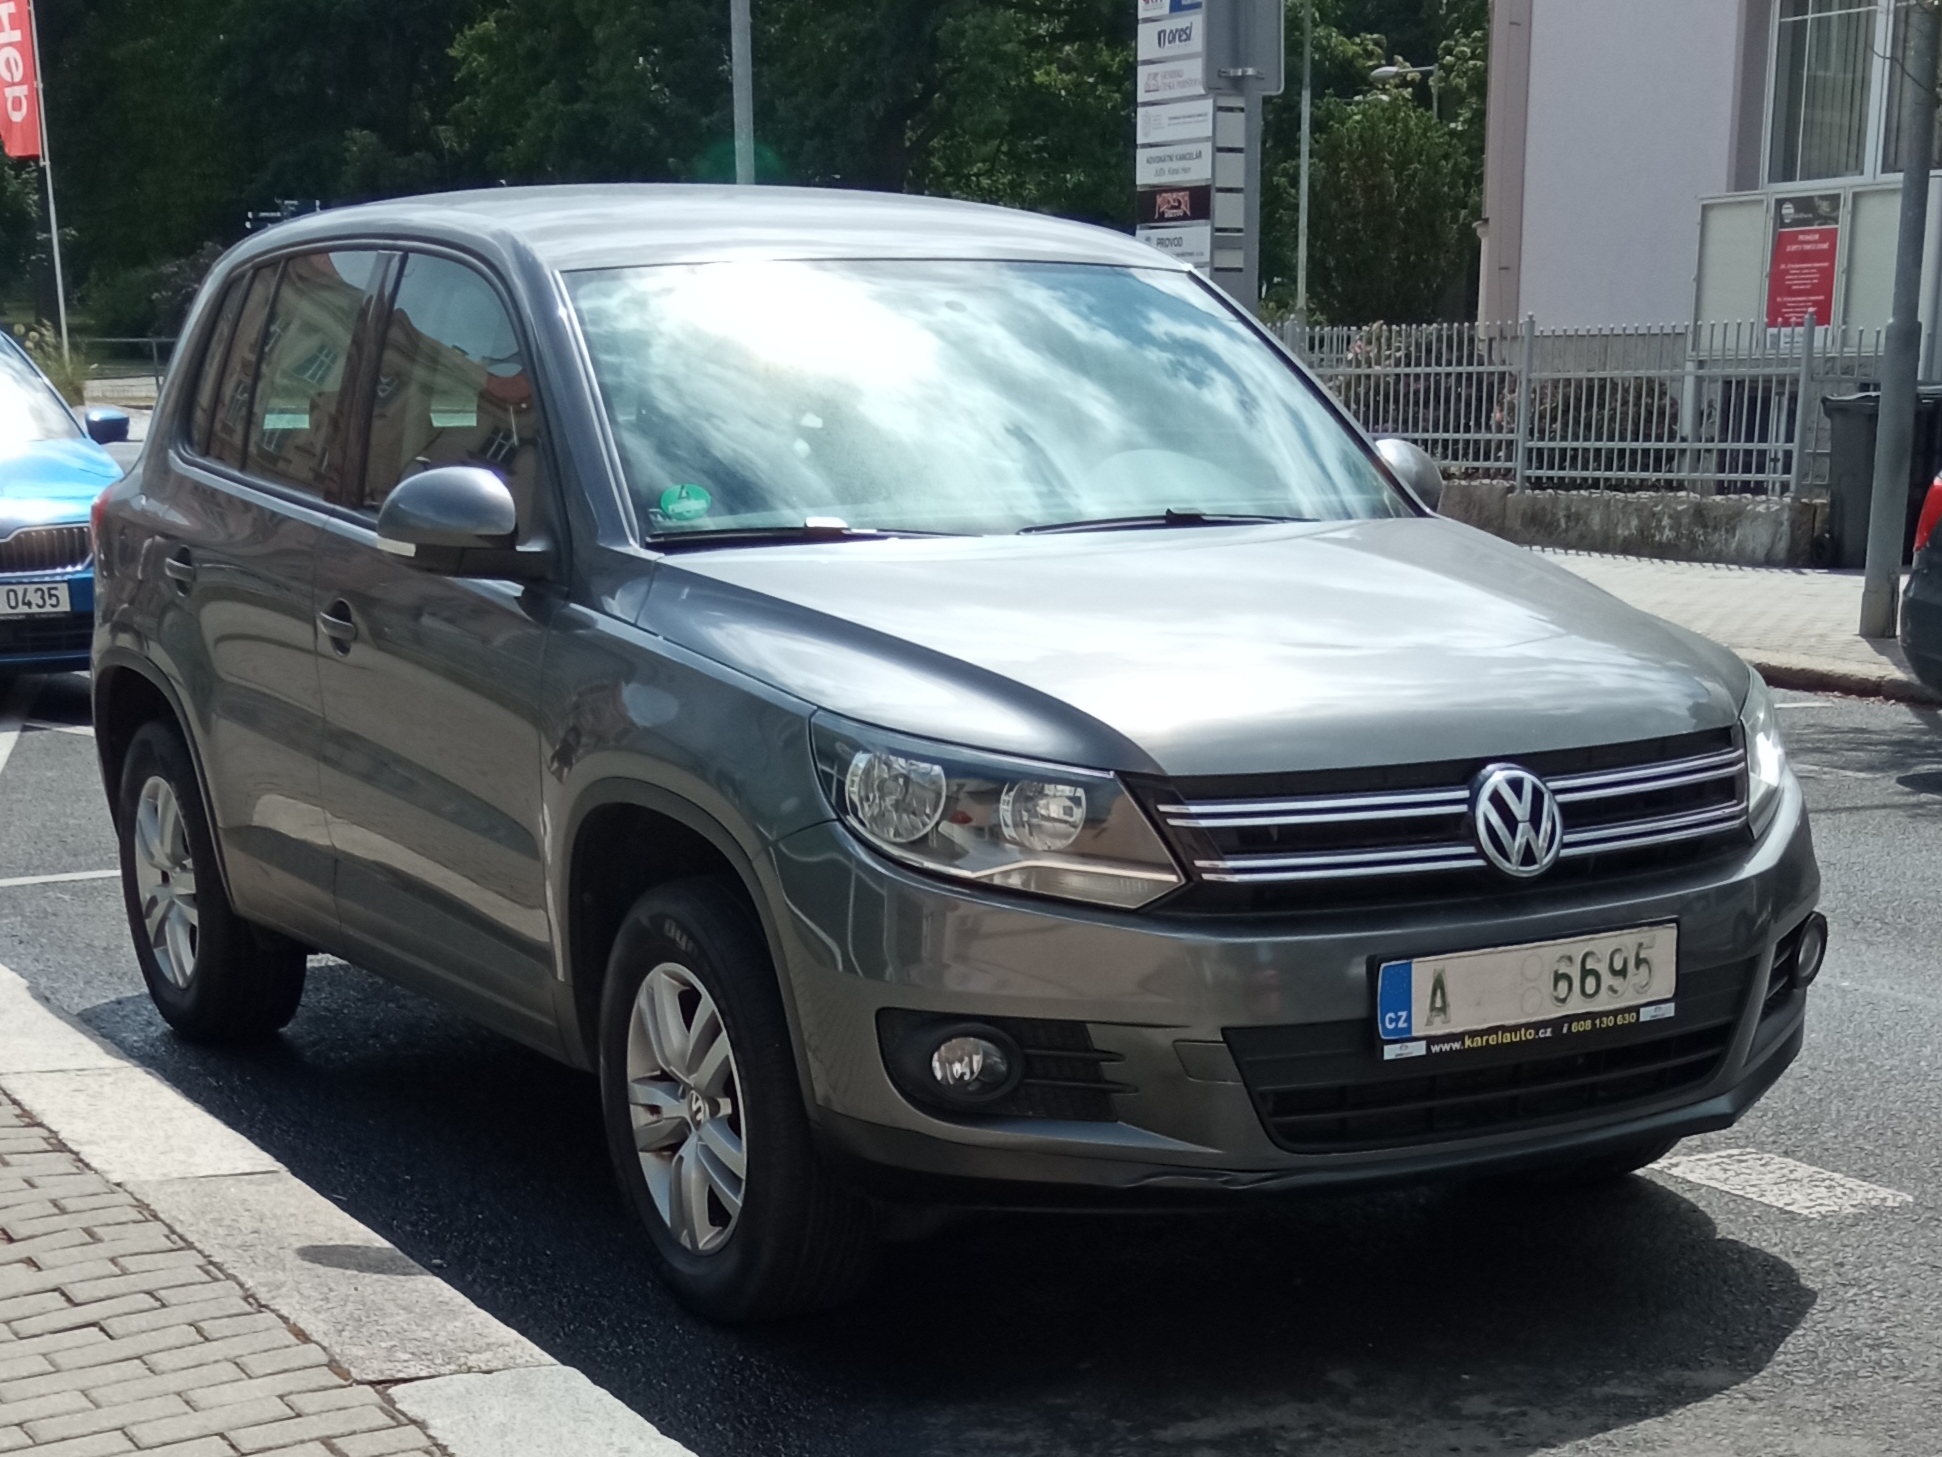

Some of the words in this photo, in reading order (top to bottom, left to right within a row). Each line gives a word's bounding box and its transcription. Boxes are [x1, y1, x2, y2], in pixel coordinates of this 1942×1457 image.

[6, 586, 60, 610] 0435
[1384, 1010, 1409, 1029] CZ
[1571, 1019, 1592, 1033] 608
[1595, 1015, 1615, 1029] 130
[1616, 1012, 1637, 1025] 630
